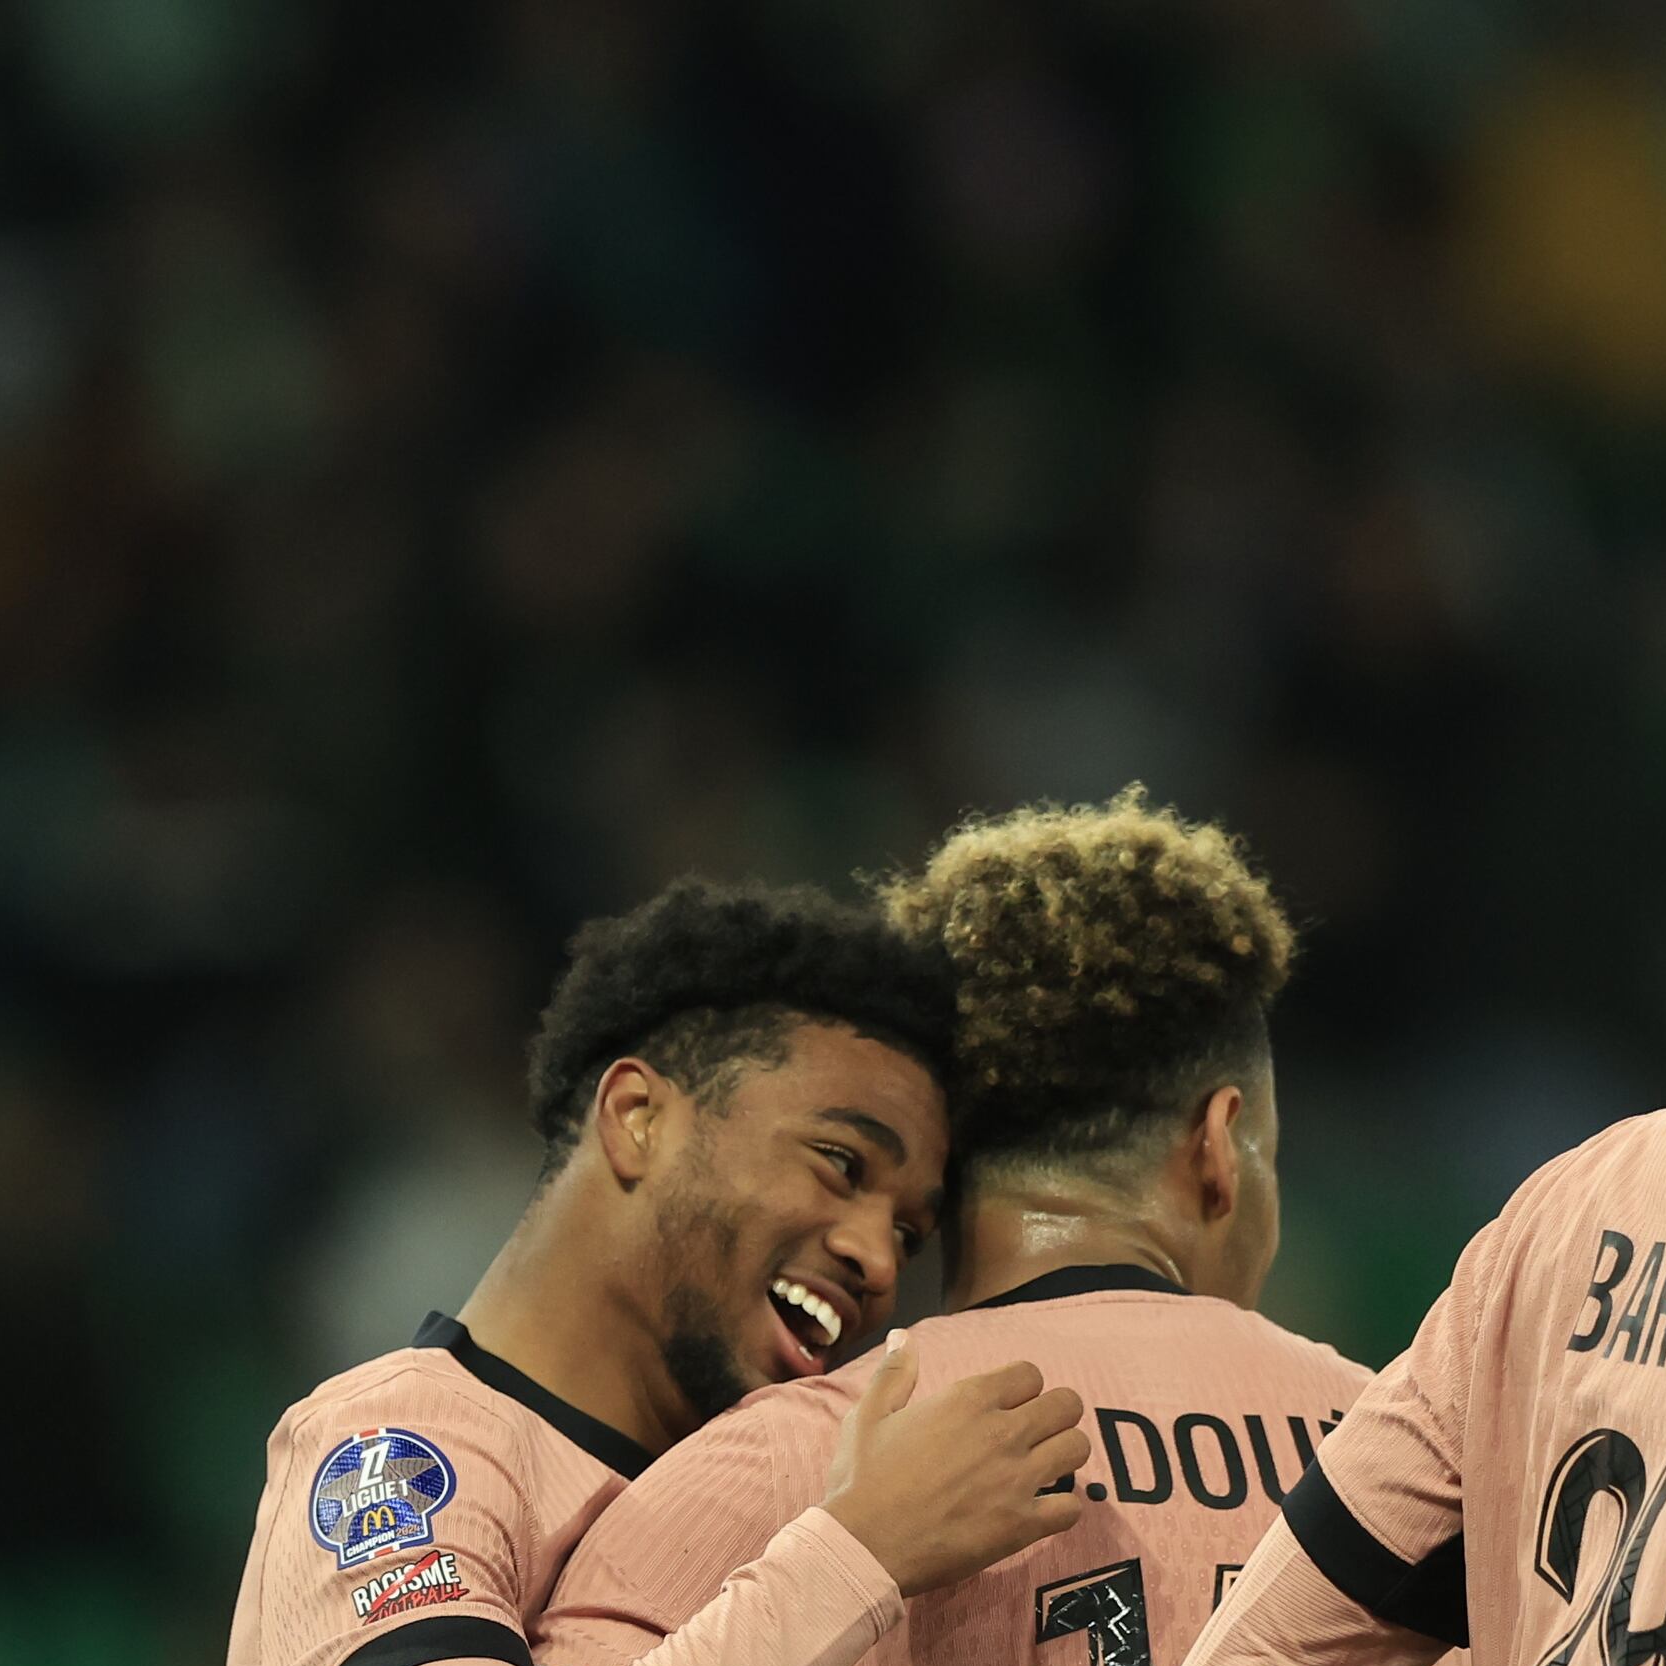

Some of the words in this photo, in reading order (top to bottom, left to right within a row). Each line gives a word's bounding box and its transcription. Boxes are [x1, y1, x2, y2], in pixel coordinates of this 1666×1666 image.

[341, 1481, 398, 1518] LIGUE
[346, 1530, 395, 1557] CHAMPION
[352, 1554, 460, 1617] RACISME
